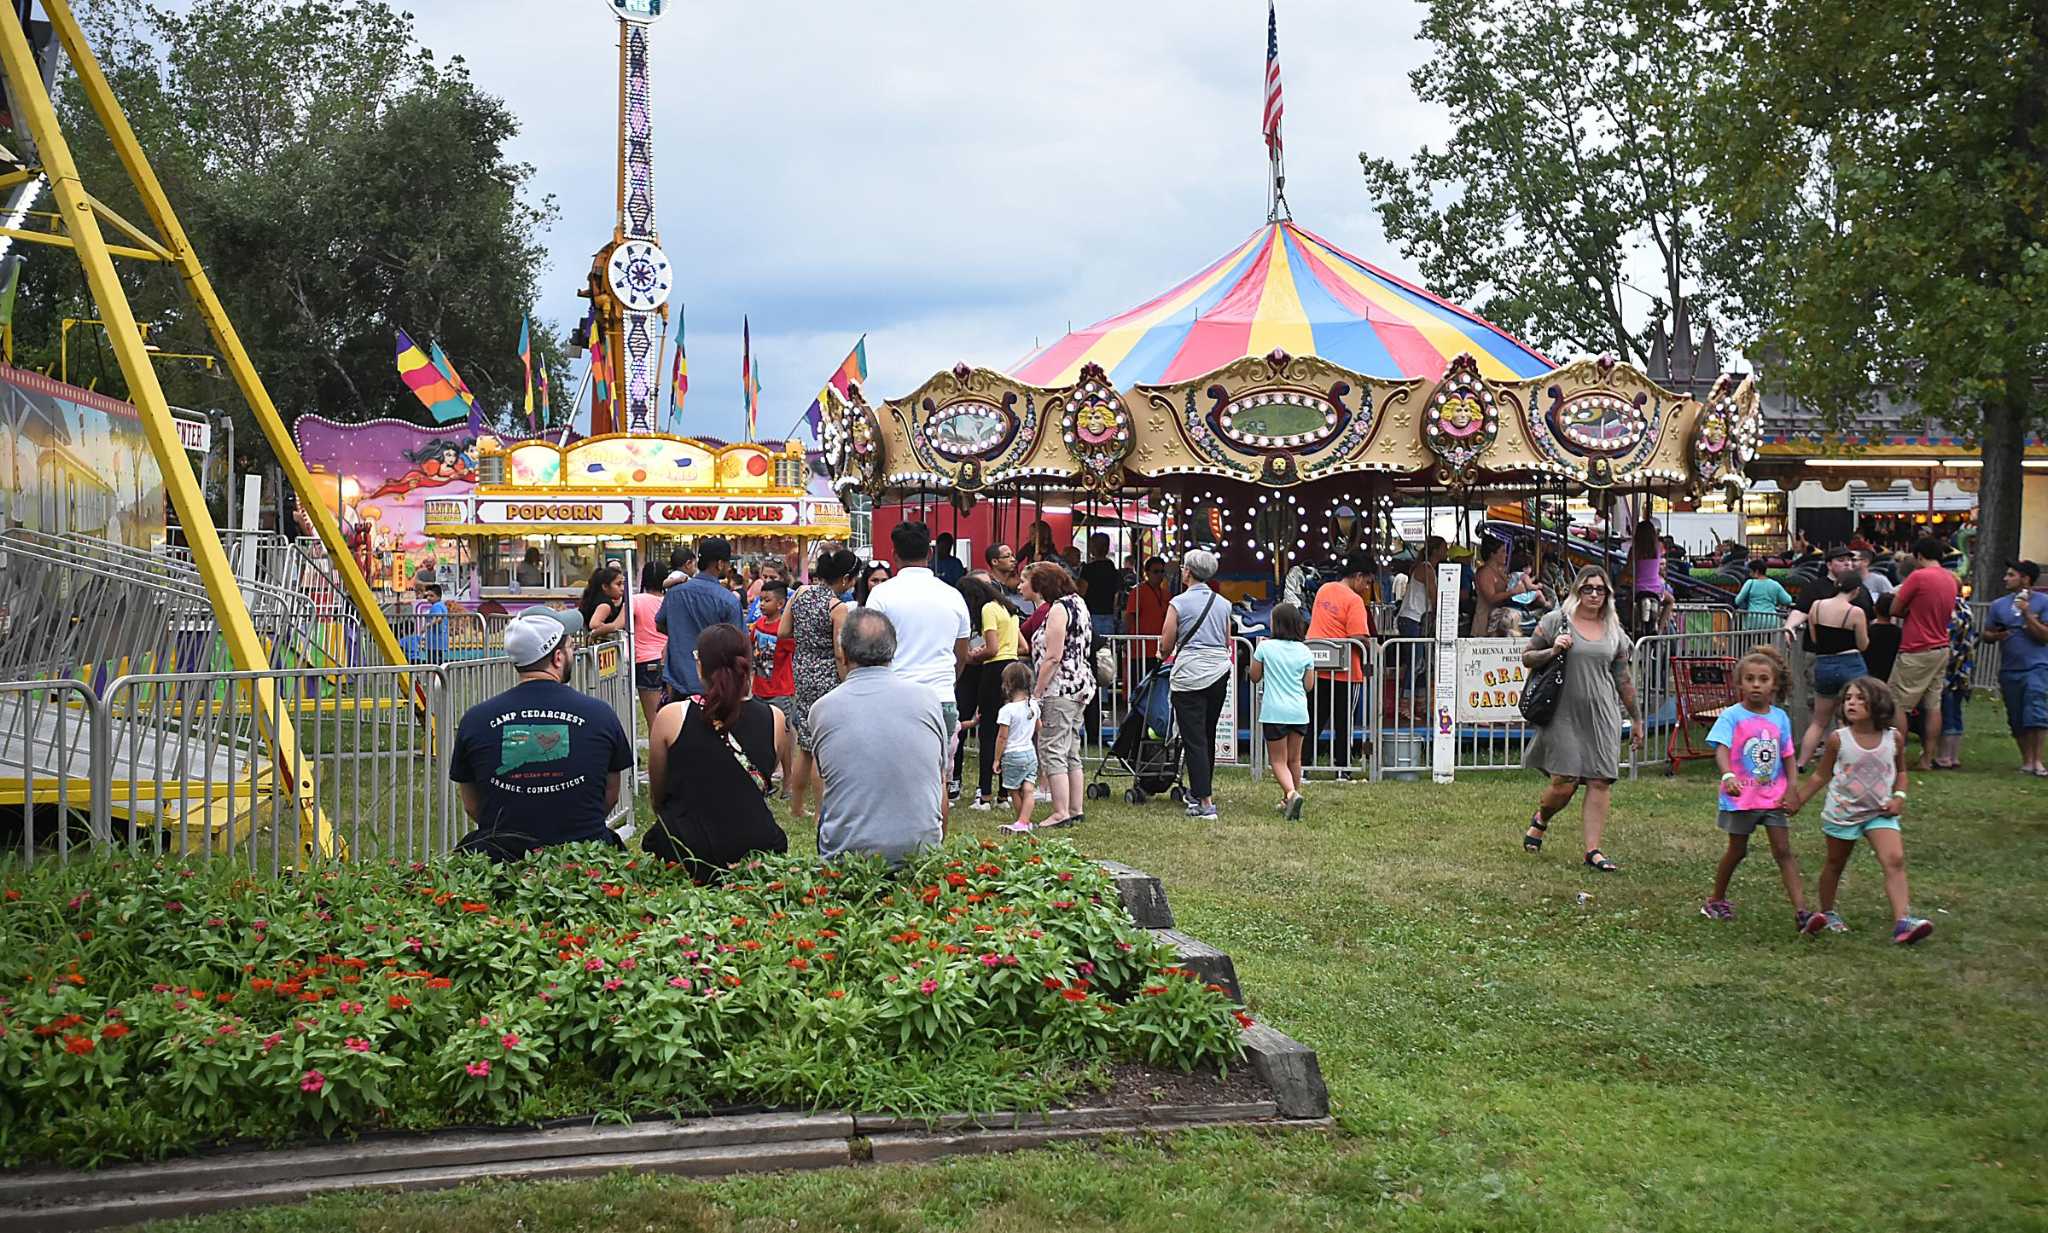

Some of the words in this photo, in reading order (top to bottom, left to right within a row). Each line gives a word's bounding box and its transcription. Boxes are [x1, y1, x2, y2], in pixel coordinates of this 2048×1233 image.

[506, 504, 603, 521] POPCORN
[662, 505, 719, 521] CANDY
[724, 504, 784, 521] APPLES
[599, 650, 615, 670] EXIT
[1312, 651, 1328, 659] TER
[1472, 647, 1504, 655] MARENNA
[1484, 666, 1524, 687] GRA
[1469, 690, 1519, 708] CARO
[490, 712, 517, 728] CAMP
[521, 710, 586, 726] CEDARCHEST
[527, 775, 585, 794] CONNECTICUT
